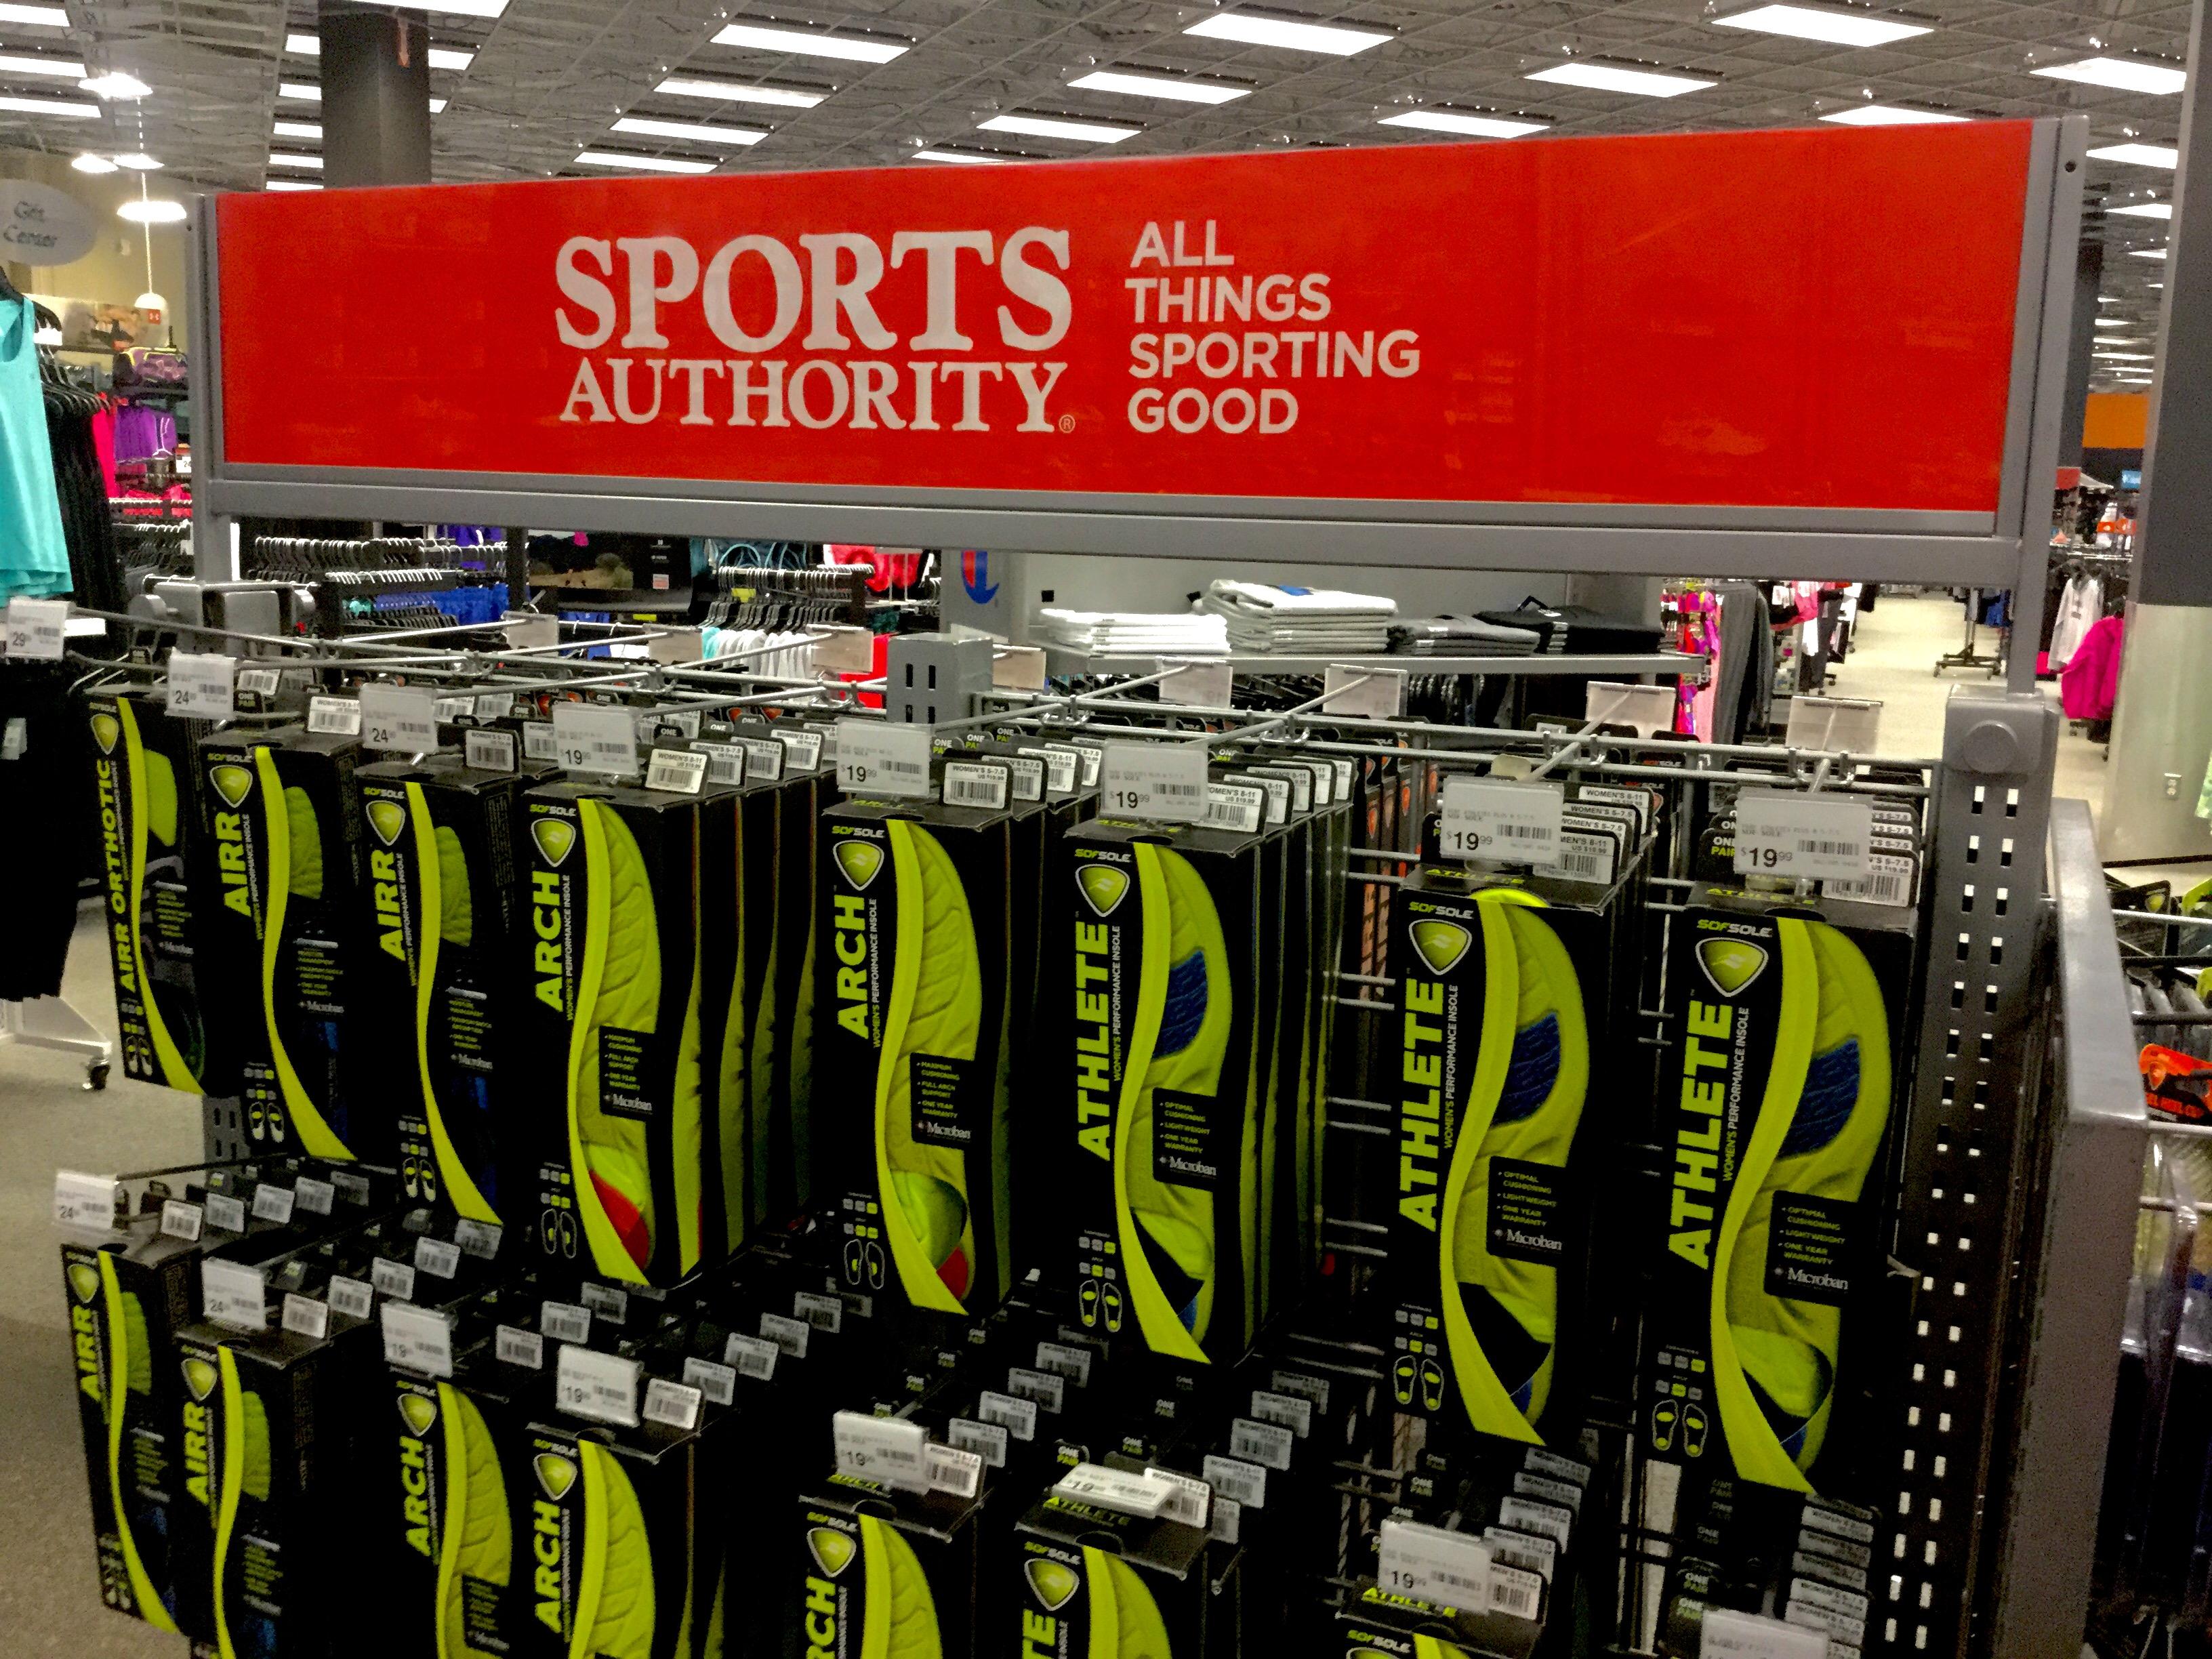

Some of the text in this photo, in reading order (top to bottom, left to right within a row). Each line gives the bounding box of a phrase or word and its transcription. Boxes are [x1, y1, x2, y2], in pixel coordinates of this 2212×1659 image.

[1130, 220, 1234, 268] ALL
[554, 226, 1073, 352] SPORTS
[1124, 272, 1331, 323] THINGS
[1128, 329, 1420, 378] SPORTING
[559, 357, 1067, 433] AUTHORITY
[1127, 388, 1298, 434] GOOD
[934, 739, 952, 748] ONE
[966, 734, 985, 742] ONE
[997, 728, 1014, 736] ONE
[952, 765, 985, 774] WOMEN'S
[1208, 787, 1239, 796] OMEN'S
[1586, 790, 1624, 800] WOMEN'S
[97, 758, 127, 914] ORTHOTIC
[1561, 818, 1599, 828] WOMEN'S
[1561, 836, 1587, 845] MEN'S
[1571, 806, 1610, 815] WOMEN'S
[215, 811, 252, 918] AIRR
[371, 849, 407, 962] AIRR
[868, 898, 878, 933] INSOLE
[1408, 901, 1474, 920] SOFSOLE
[1697, 919, 1773, 938] SOFSOLE
[114, 922, 136, 994] AIRR
[531, 870, 563, 1012] ARCH
[834, 895, 869, 1040] ARCH
[869, 933, 880, 1004] PERFORMANCE
[1112, 925, 1122, 1082] WOMEN'S PERFORMANCE INSOLE
[1075, 921, 1111, 1162] ATHLETE
[1443, 984, 1458, 1149] WOMEN'S PERFORMANCE INSOLE
[1399, 978, 1444, 1233] ATHLETE
[1722, 1007, 1750, 1182] WOMEN'S PERFORMANCE INSOLE
[1169, 1155, 1216, 1176] Microban
[1668, 1000, 1733, 1270] ATHLETE
[1506, 1229, 1562, 1251] Microban
[1787, 1267, 1848, 1290] Microban
[73, 1305, 102, 1403] AIRR
[182, 1401, 209, 1506] AIRR
[398, 1436, 430, 1557] ARCH
[533, 1500, 562, 1634] ARCH
